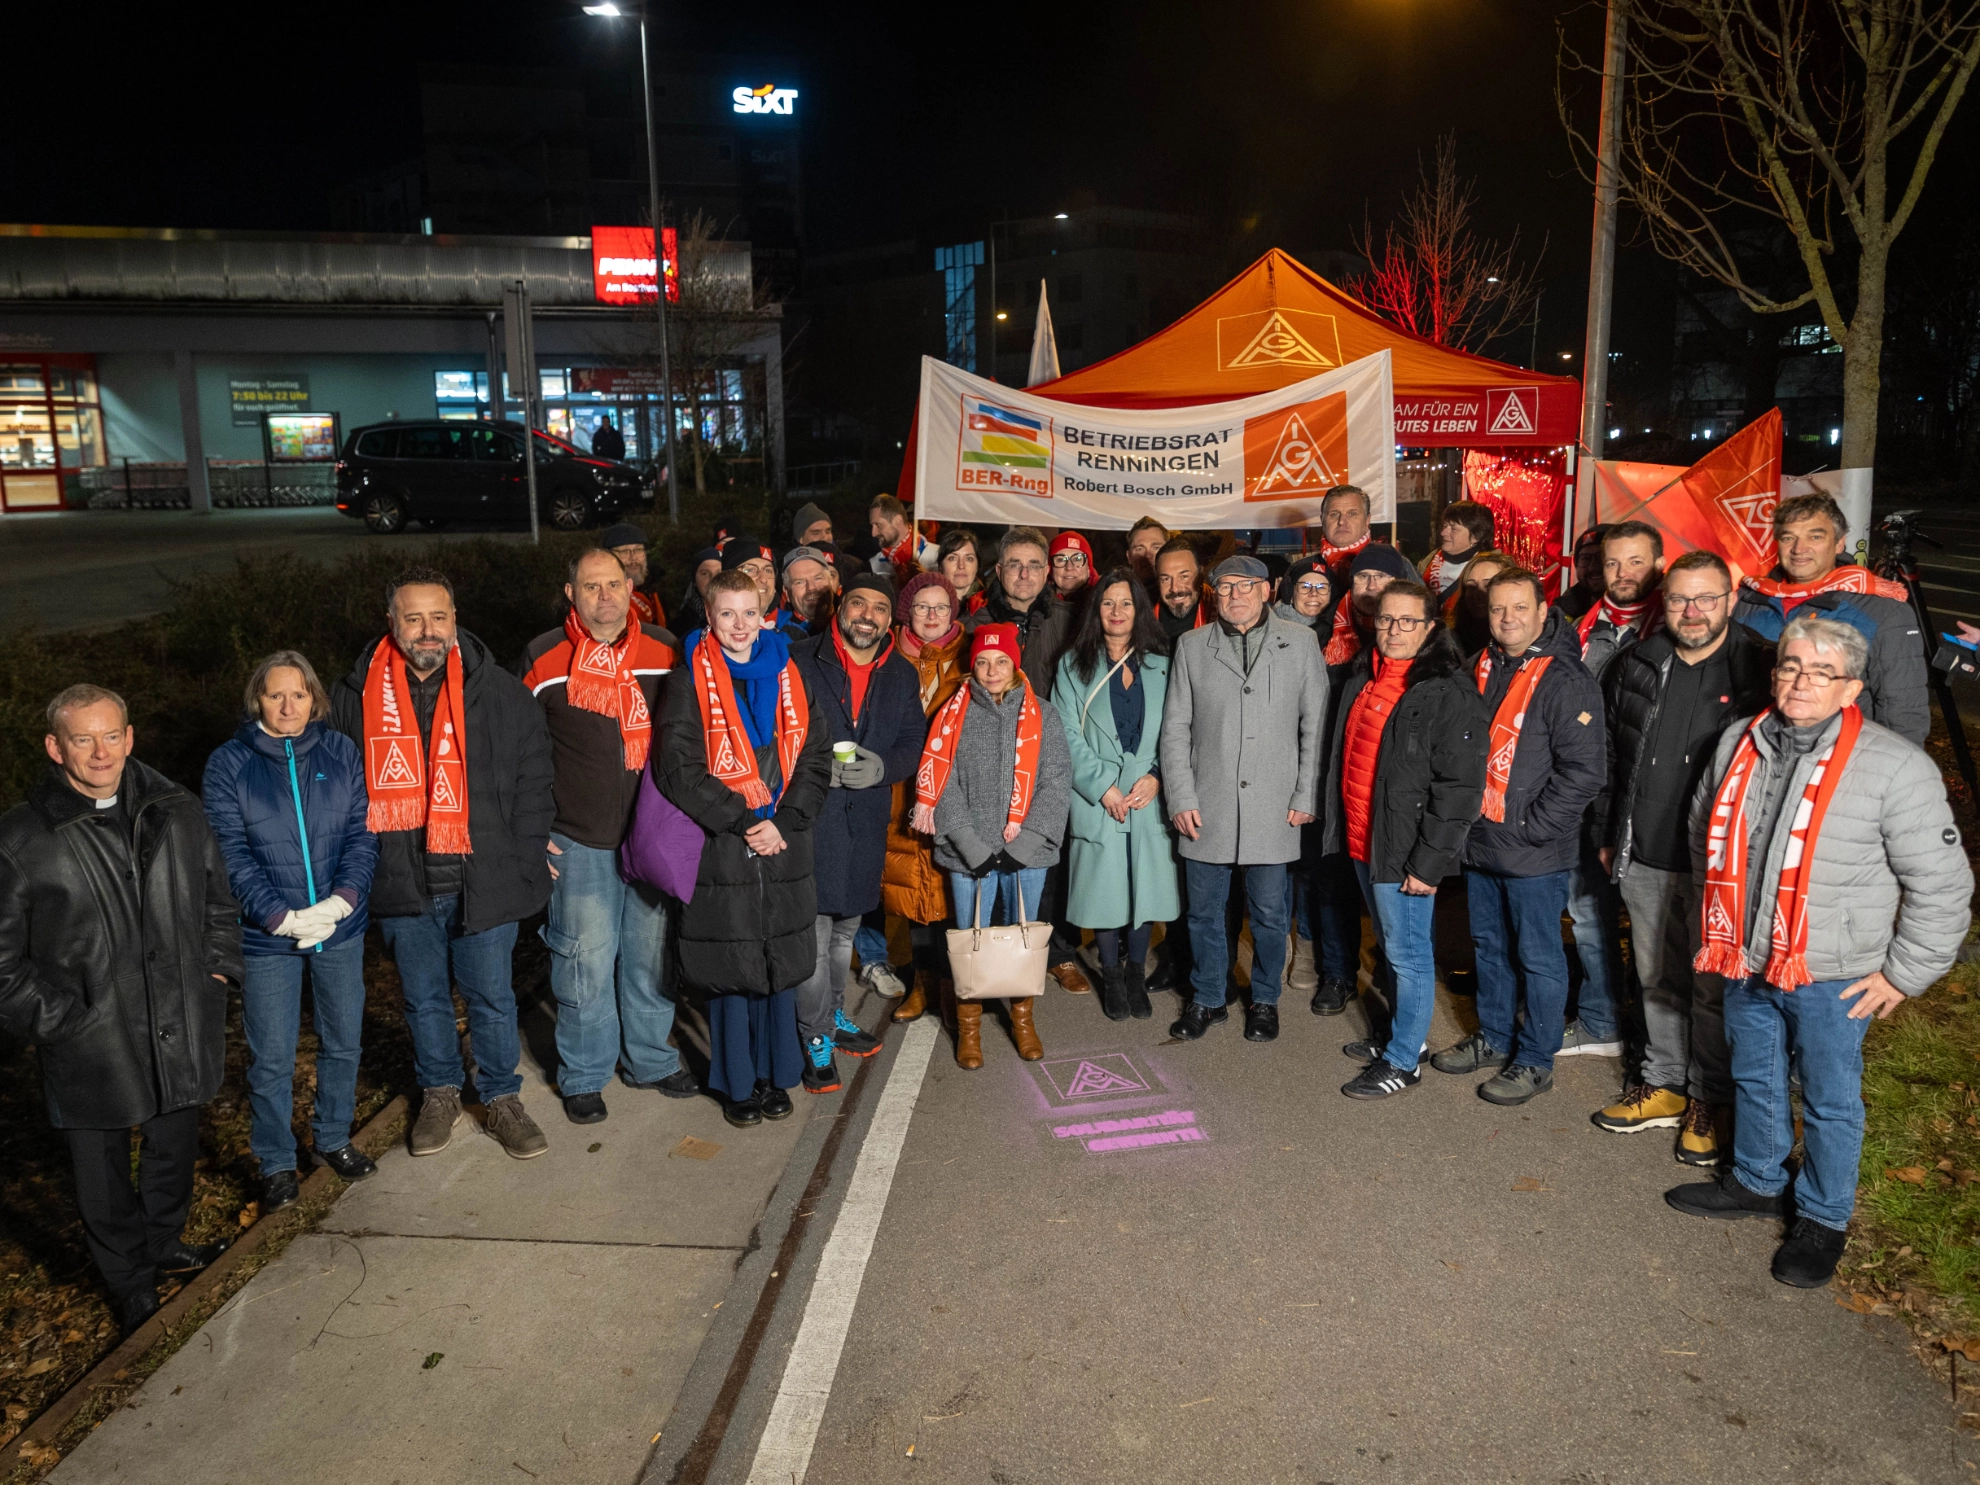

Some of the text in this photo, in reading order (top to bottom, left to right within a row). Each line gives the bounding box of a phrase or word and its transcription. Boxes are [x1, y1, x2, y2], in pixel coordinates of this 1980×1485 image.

[733, 85, 798, 115] SIXT
[257, 391, 273, 400] bis
[290, 391, 308, 400] Uhr
[1394, 401, 1479, 416] AM FÜR EIN
[1432, 419, 1478, 433] LEBEN
[1064, 426, 1234, 451] BETRIEBSRAT
[1077, 449, 1219, 473] RENNINGEN
[961, 468, 1049, 495] BER-Rng
[1064, 476, 1234, 496] Robert Bosch GmbH
